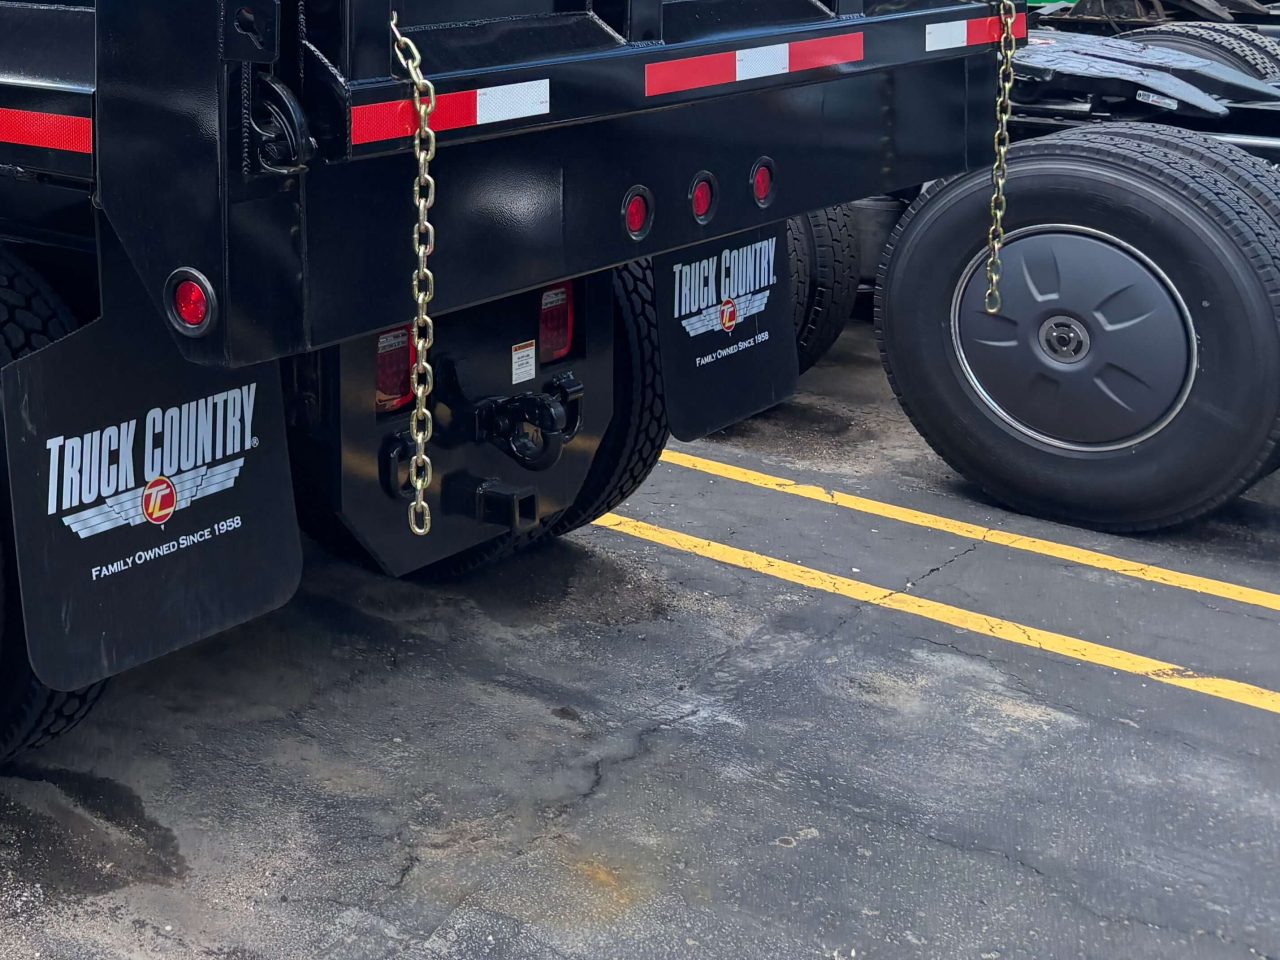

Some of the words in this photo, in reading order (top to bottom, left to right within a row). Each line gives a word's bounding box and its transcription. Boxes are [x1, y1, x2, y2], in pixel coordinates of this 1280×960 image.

[673, 256, 718, 318] TRUCK
[696, 352, 718, 367] FAMILY
[717, 344, 739, 359] OWNED
[738, 337, 755, 351] SINCE
[755, 331, 769, 344] 1958
[46, 419, 137, 516] TRUCK
[91, 556, 133, 581] FAMILY
[135, 541, 178, 565] OWNED
[179, 528, 212, 550] SINCE
[213, 516, 242, 537] 1958
